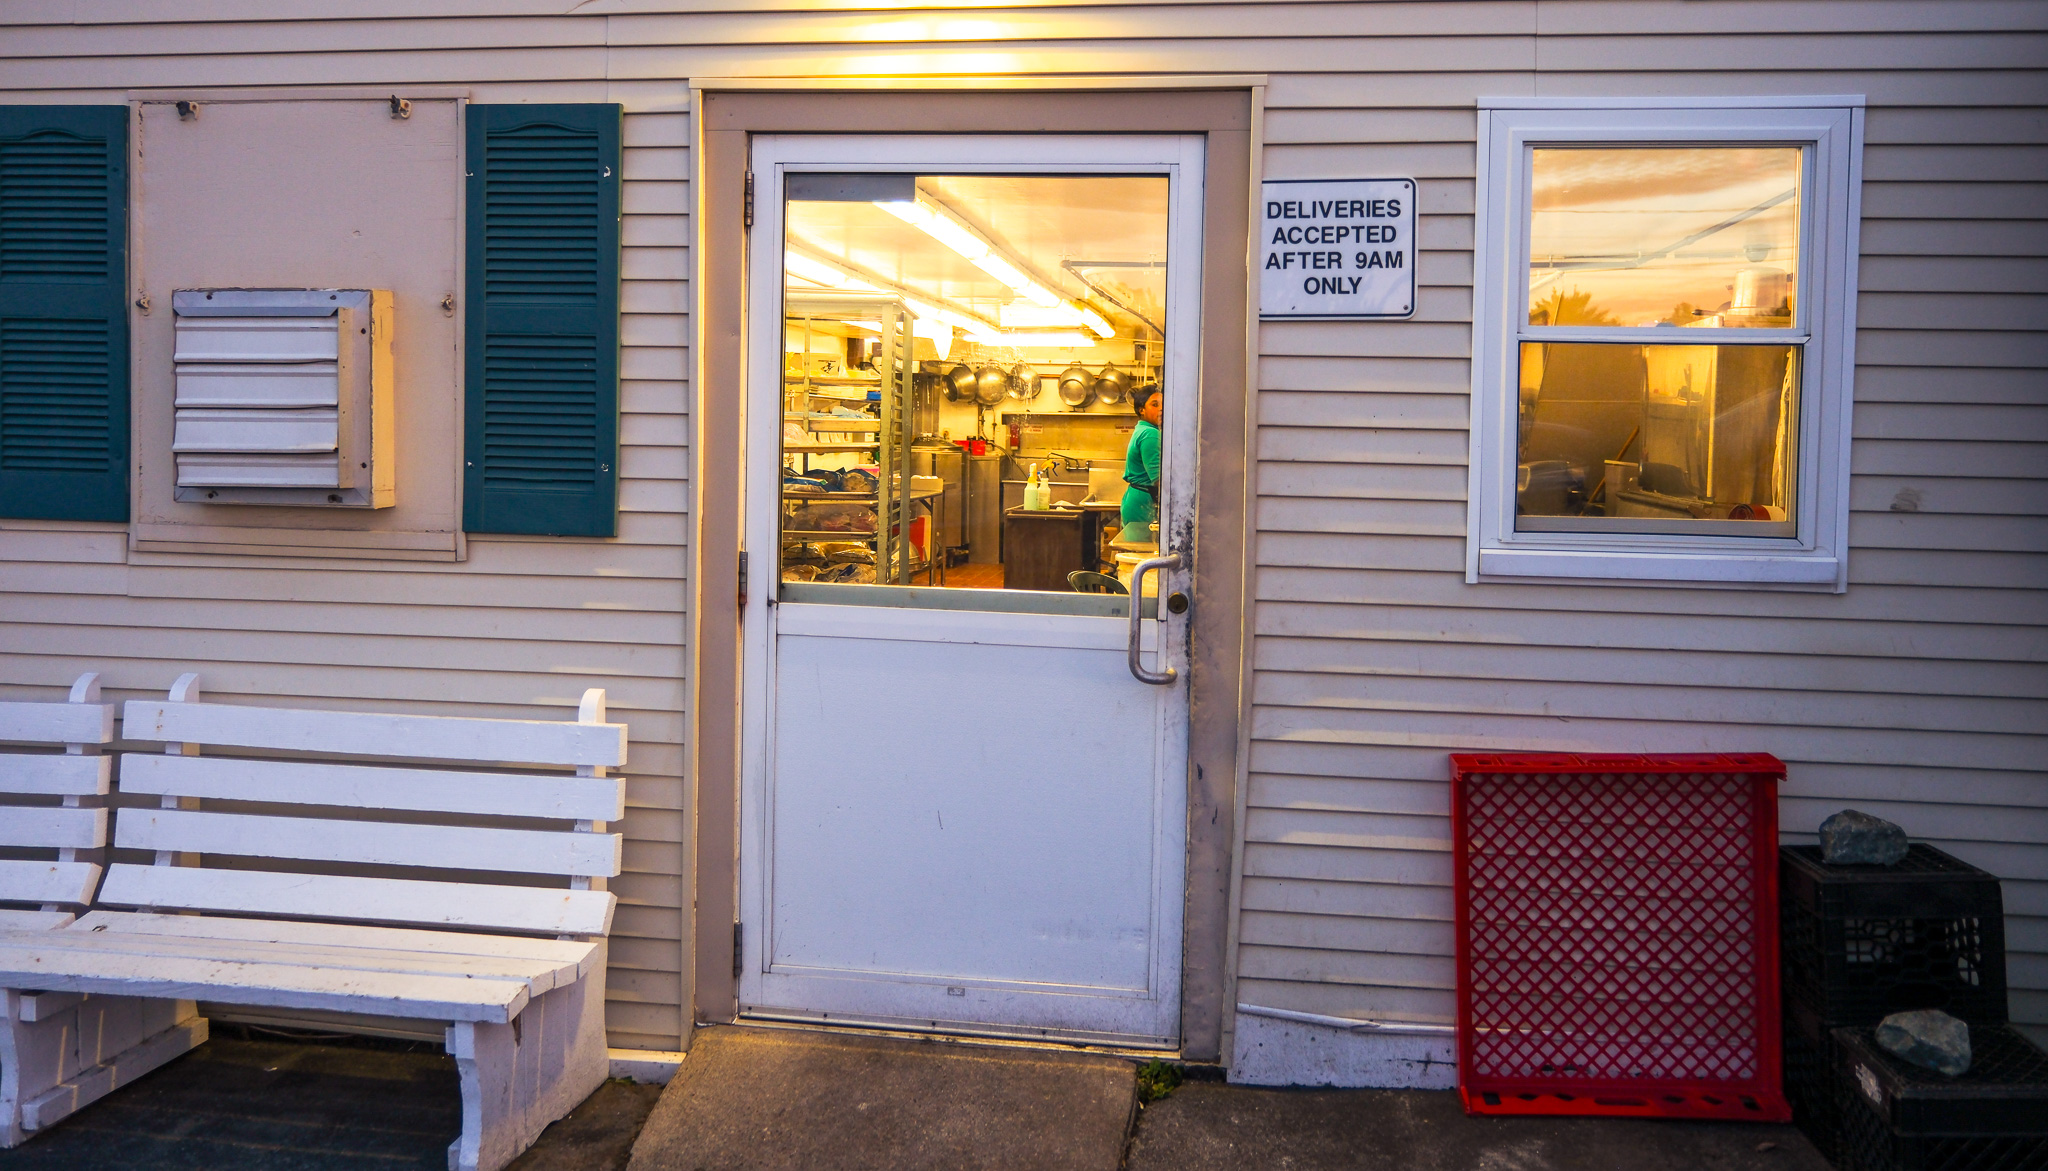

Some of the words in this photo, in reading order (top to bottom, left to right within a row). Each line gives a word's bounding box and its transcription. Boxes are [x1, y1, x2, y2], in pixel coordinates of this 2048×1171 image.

[1267, 200, 1401, 219] DELIVERIES
[1272, 226, 1396, 244] ACCEPTED
[1266, 252, 1342, 269] AFTER
[1356, 251, 1402, 269] 9AM
[1304, 277, 1362, 295] ONLY
